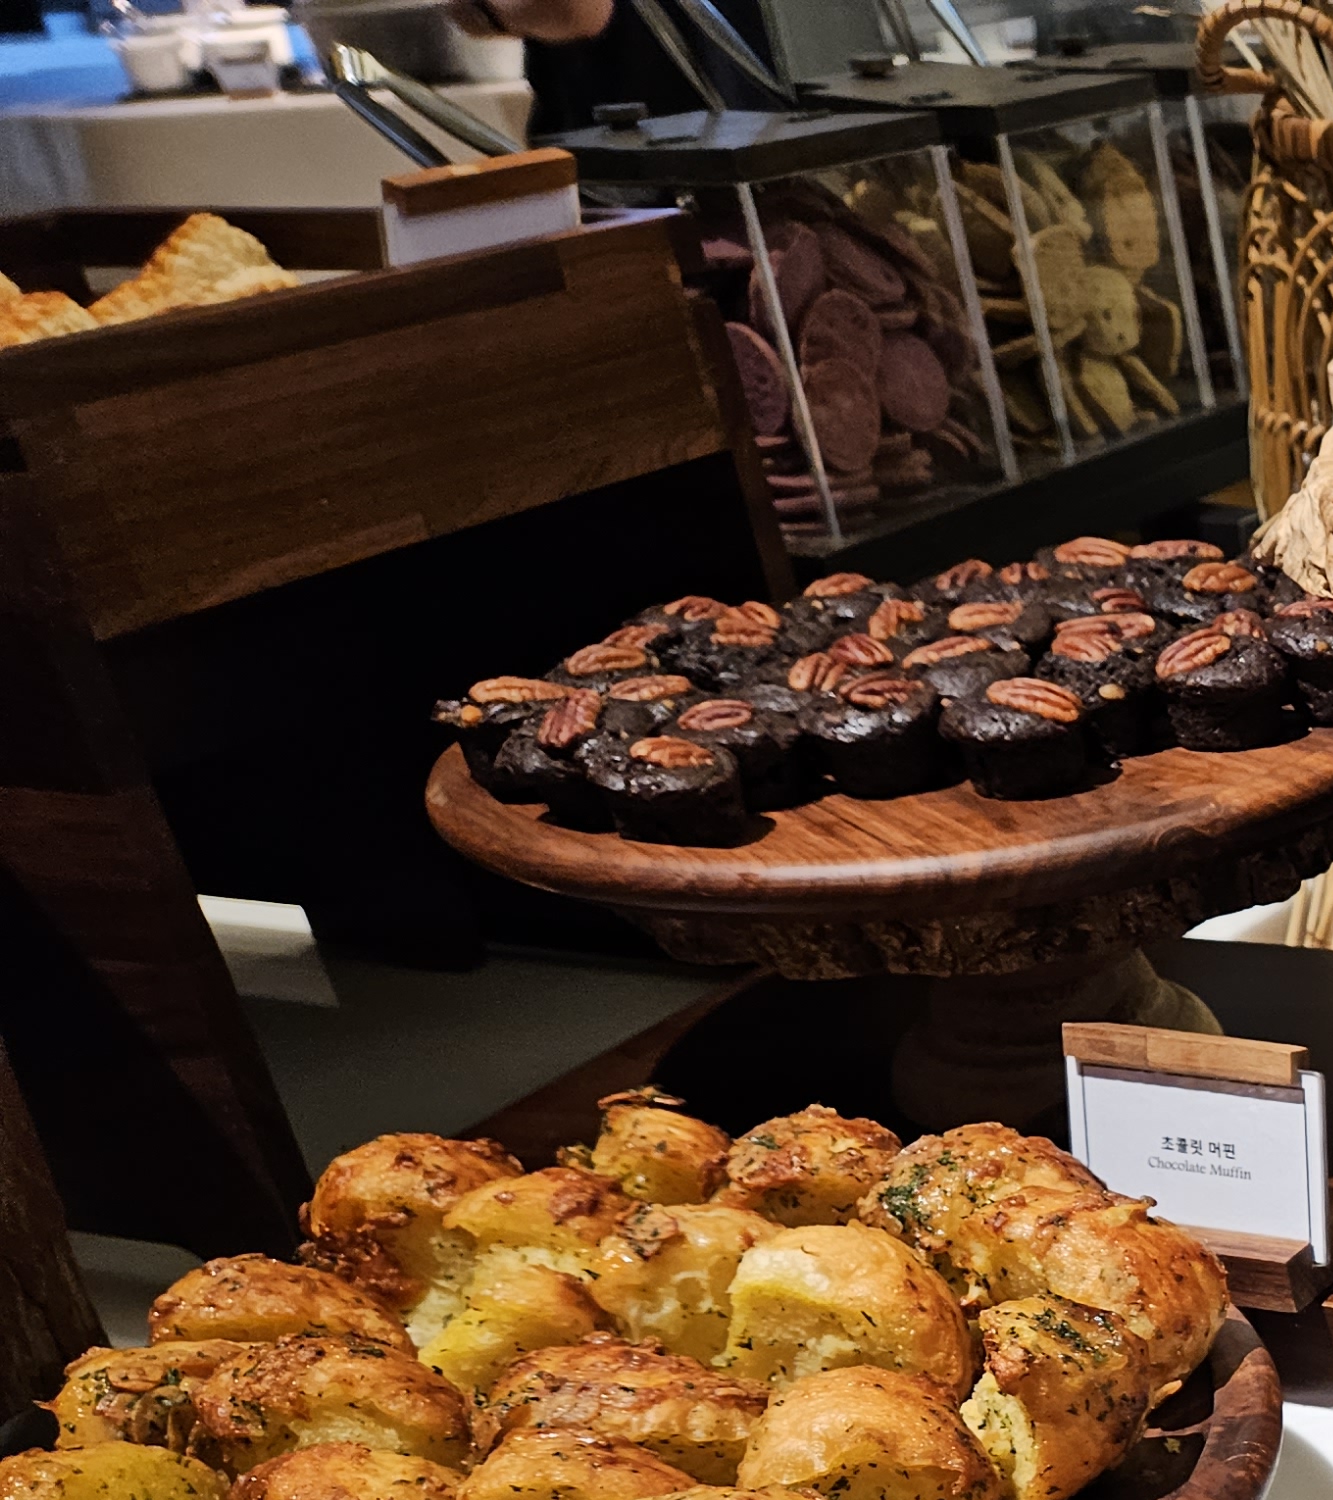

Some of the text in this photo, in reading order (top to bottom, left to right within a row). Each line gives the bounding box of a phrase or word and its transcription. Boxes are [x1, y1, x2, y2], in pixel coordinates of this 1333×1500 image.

[1208, 1141, 1236, 1159] 머핀
[1147, 1156, 1252, 1180] Chocolate Muffin
